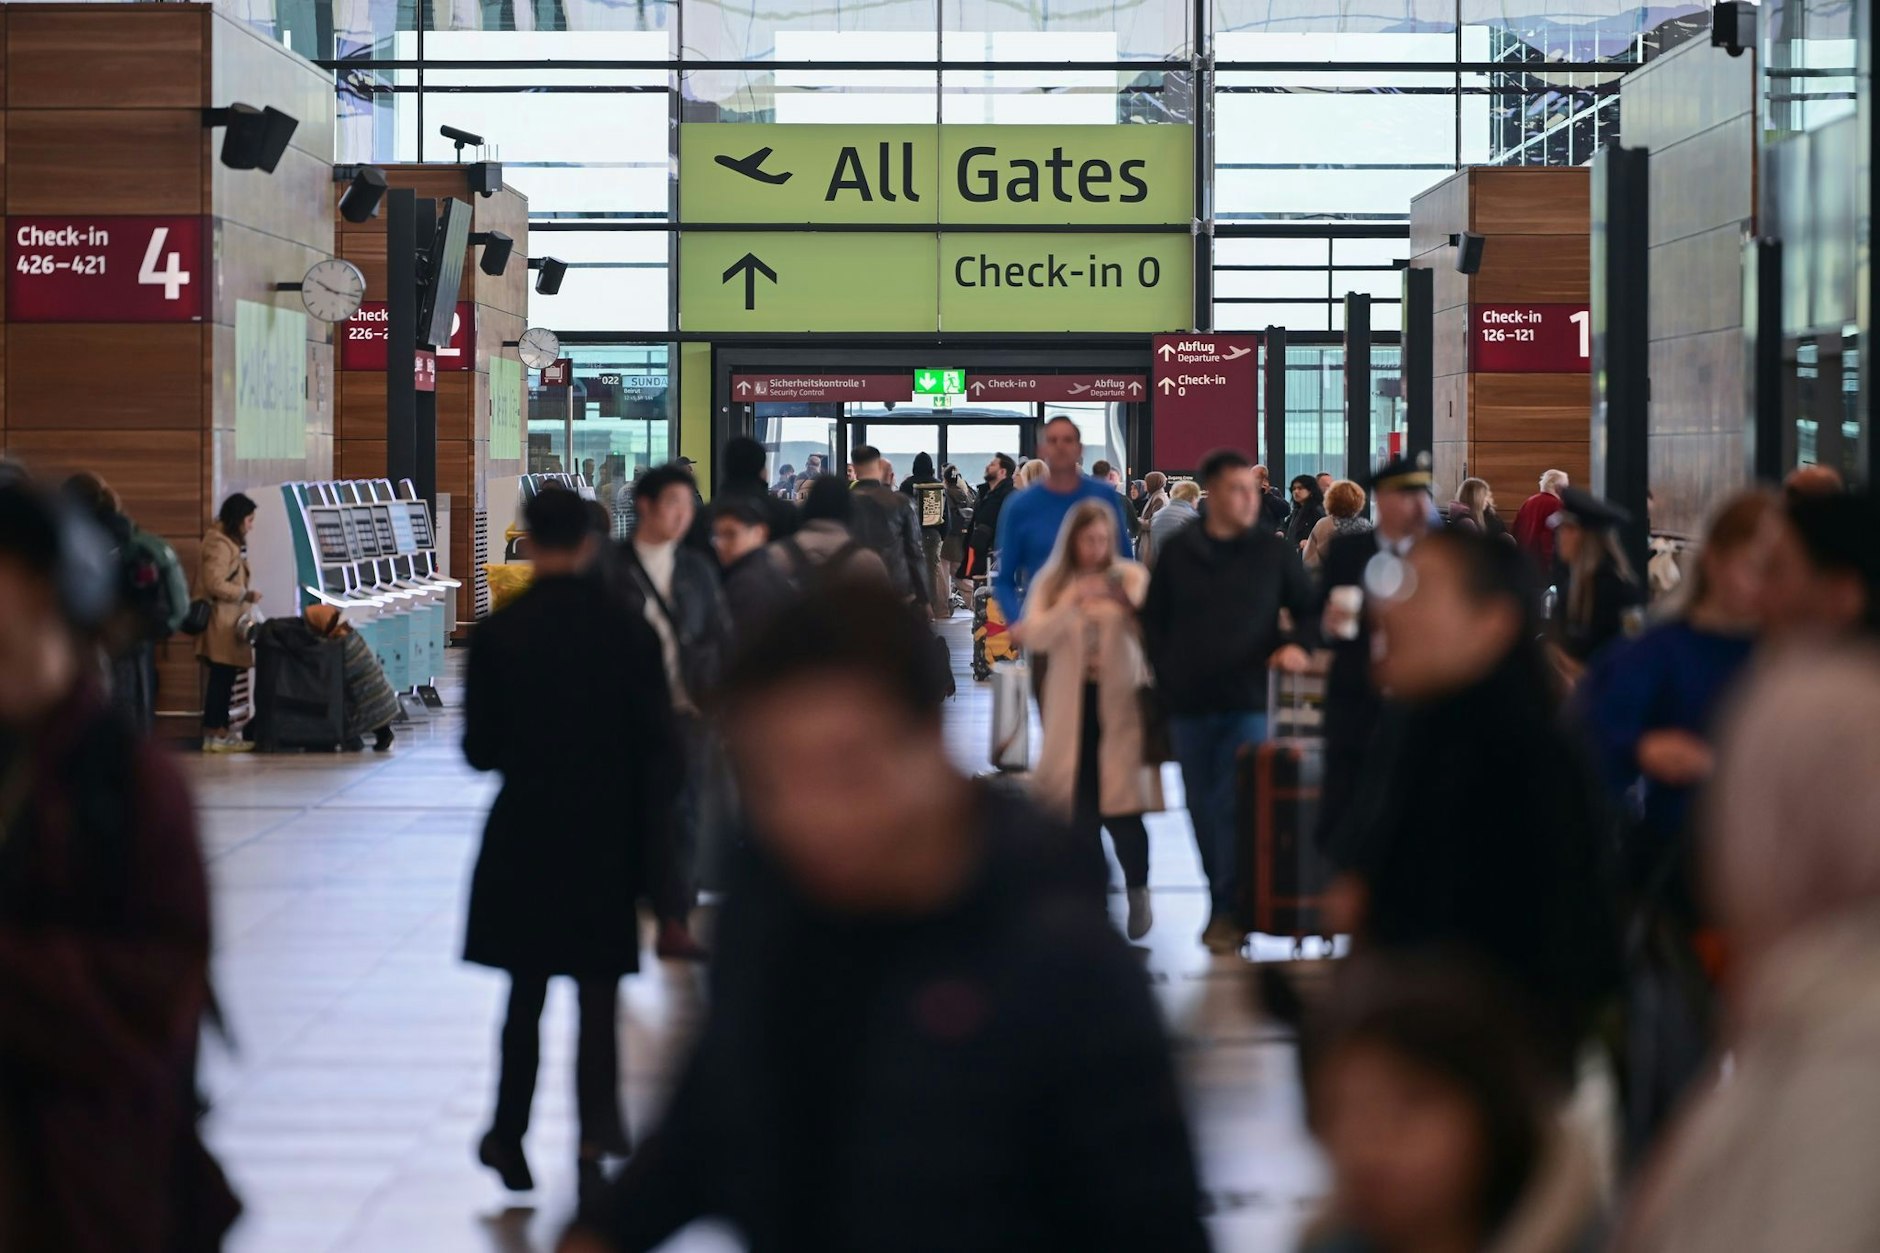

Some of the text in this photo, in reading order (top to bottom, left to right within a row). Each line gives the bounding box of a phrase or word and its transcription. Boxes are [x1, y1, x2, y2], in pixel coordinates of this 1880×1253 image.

[824, 142, 1148, 203] All Gates
[16, 255, 106, 275] 426–421
[17, 225, 190, 300] Check-in 4
[955, 254, 1160, 288] Check-in 0
[1482, 310, 1589, 357] Check-in 1
[1177, 341, 1215, 354] Abflug
[1177, 354, 1220, 363] Departure
[601, 376, 619, 385] 022
[769, 379, 859, 388] Sicherheitskontrolle
[988, 379, 1036, 388] Check-in 0
[1094, 379, 1125, 389] Abflug
[1178, 374, 1226, 385] Check-in
[769, 389, 798, 397] Security
[1090, 389, 1125, 398] Departure
[1178, 386, 1186, 397] 0
